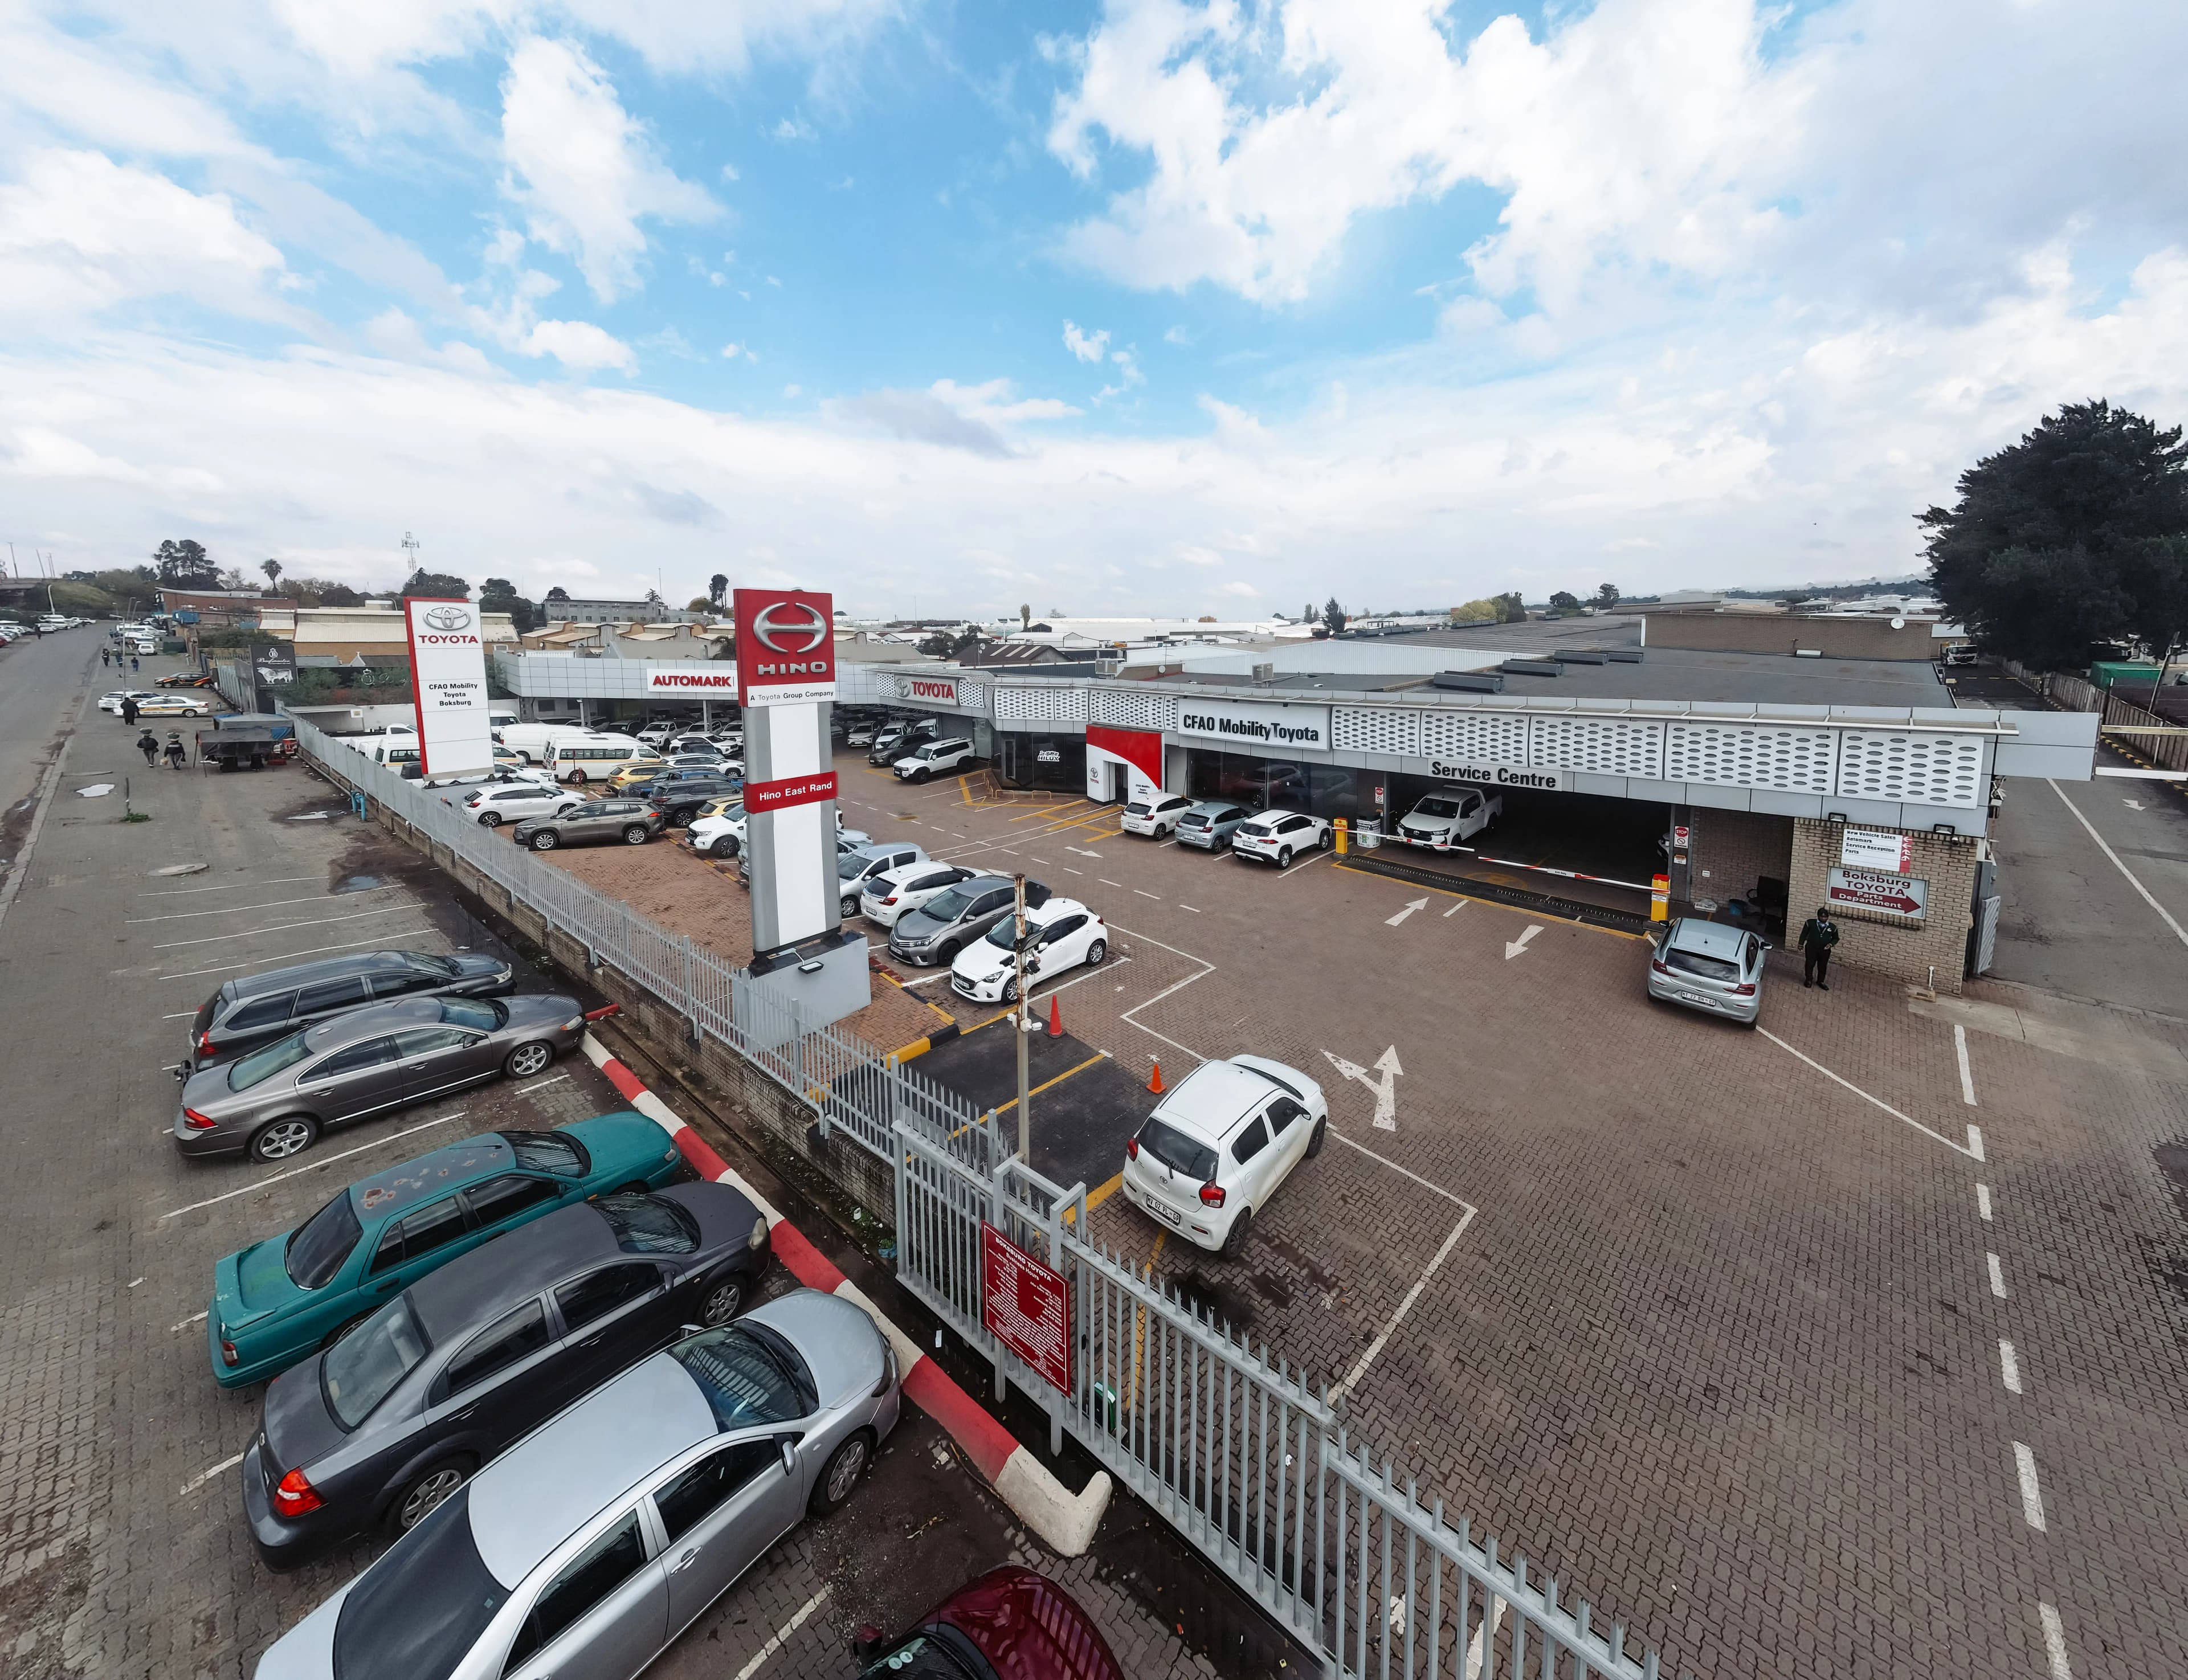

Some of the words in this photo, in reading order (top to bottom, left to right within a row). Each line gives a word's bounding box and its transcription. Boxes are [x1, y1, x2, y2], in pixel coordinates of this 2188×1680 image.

[418, 635, 479, 644] TOYOTA
[757, 661, 827, 676] HINO
[653, 675, 732, 687] AUTOMARK
[783, 692, 803, 700] Group
[805, 690, 834, 698] Company
[911, 681, 955, 700] TOYOTA
[1183, 714, 1215, 731] CFAO
[1219, 718, 1271, 741] Mobility
[1271, 722, 1319, 743] Toyota
[1431, 761, 1491, 781] Service
[1497, 768, 1556, 788] Centre
[759, 791, 781, 801] Hino
[785, 786, 806, 796] East
[810, 781, 832, 792] Rand
[1842, 870, 1911, 889] Boksburg
[1845, 880, 1905, 897] TOYOTA
[1839, 893, 1902, 909] Department
[1857, 891, 1883, 900] Parts
[995, 1237, 1026, 1264] BOKSBURG
[1027, 1261, 1051, 1282] TOYOTA
[1006, 1252, 1025, 1270] Business
[1026, 1268, 1039, 1281] Hours
